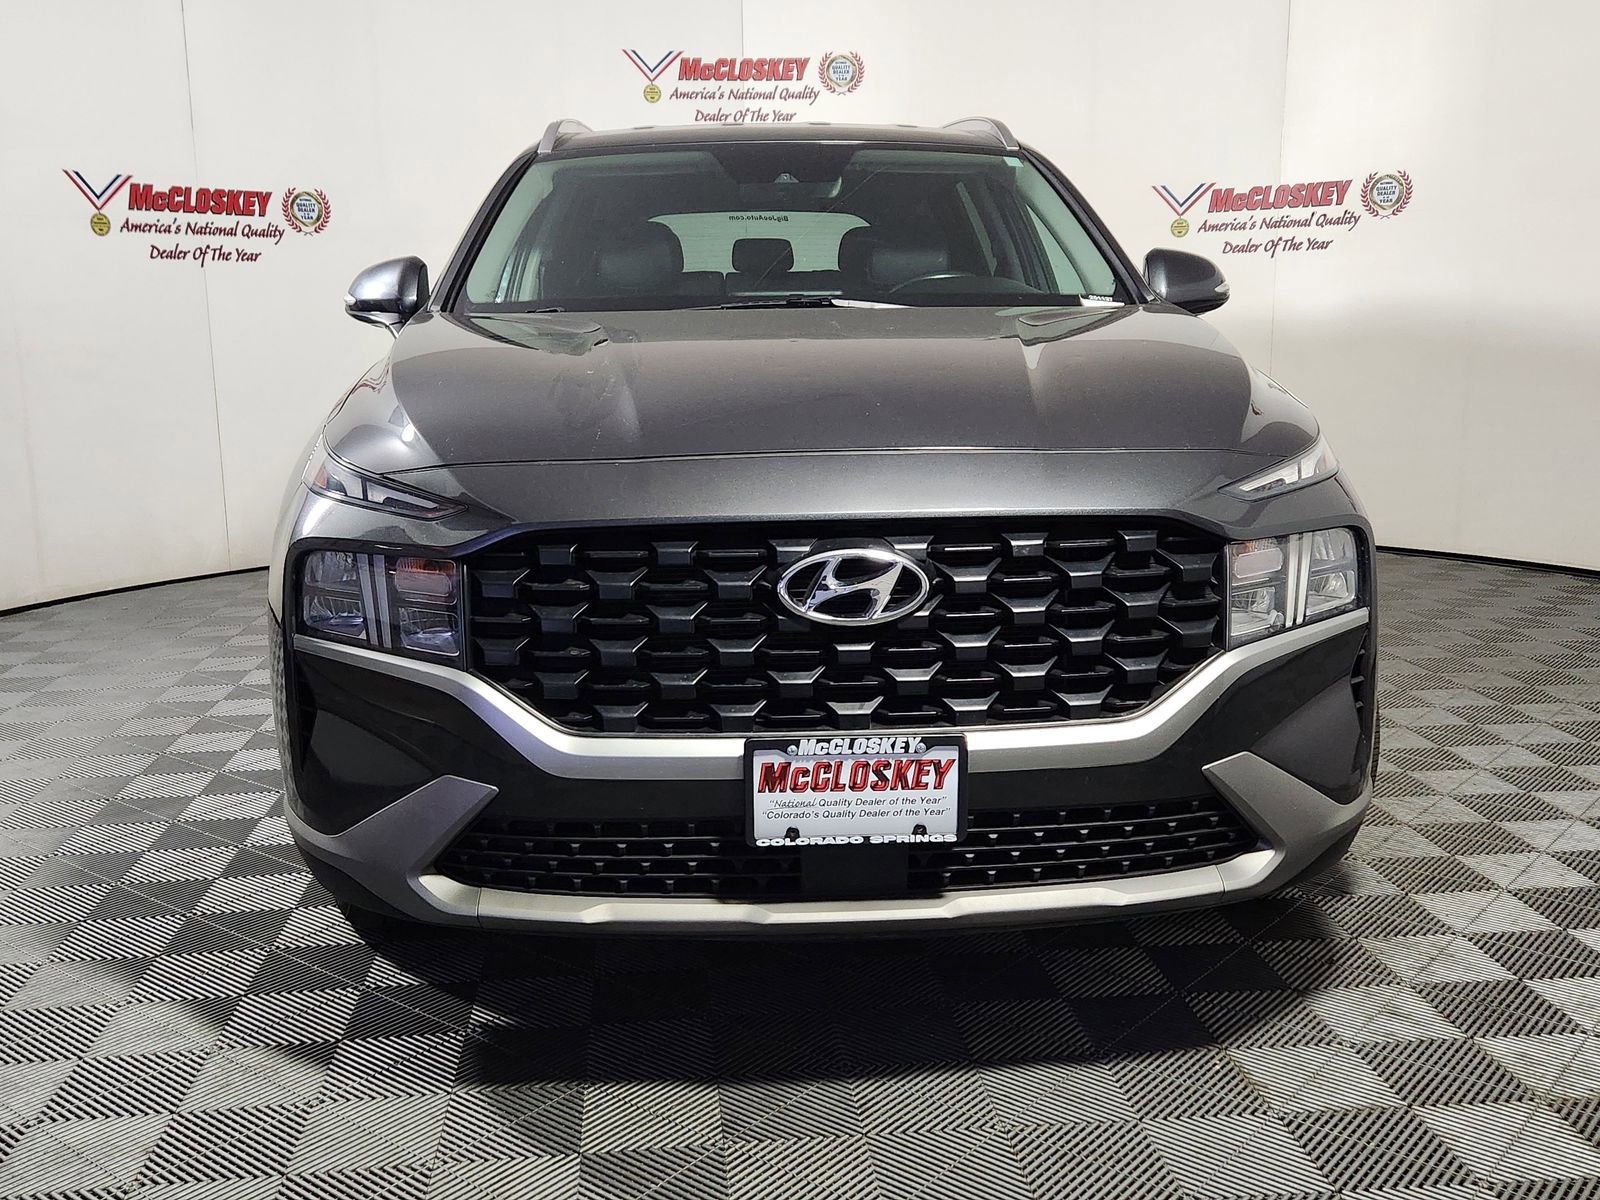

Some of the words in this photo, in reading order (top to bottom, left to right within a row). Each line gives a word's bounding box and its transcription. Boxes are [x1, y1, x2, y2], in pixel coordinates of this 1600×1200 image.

[678, 57, 811, 82] McCLOSKEY
[669, 85, 725, 100] America's
[727, 86, 776, 101] National
[779, 87, 820, 106] Quality
[695, 109, 732, 123] Dealer
[733, 108, 751, 122] Of
[750, 109, 769, 122] The
[772, 109, 797, 122] Year
[128, 182, 272, 217] McCLOSKEY
[1208, 179, 1353, 214] McCLOSKEY
[120, 217, 181, 235] America's
[185, 221, 238, 238] National
[241, 223, 285, 245] Quality
[1198, 215, 1256, 233] America's
[1259, 211, 1316, 230] National
[1315, 210, 1361, 232] Quality
[150, 243, 190, 261] Dealer
[192, 245, 211, 268] Of
[211, 244, 232, 262] The
[235, 248, 262, 262] Year
[1222, 237, 1263, 254] Dealer
[1264, 236, 1284, 258] Of
[1283, 236, 1304, 251] The
[1306, 237, 1334, 251] Year
[797, 737, 922, 756] McCLOSKEY
[757, 759, 956, 793] McCLOSKEY
[818, 799, 853, 808] Quality
[855, 797, 886, 806] Dealer
[889, 797, 900, 805] of
[901, 797, 917, 805] the
[822, 809, 857, 820] Quality
[859, 809, 890, 818] Dealer
[893, 808, 903, 817] of
[905, 808, 920, 816] the
[755, 835, 864, 847] COLORADO
[870, 833, 958, 845] SPRINGS
